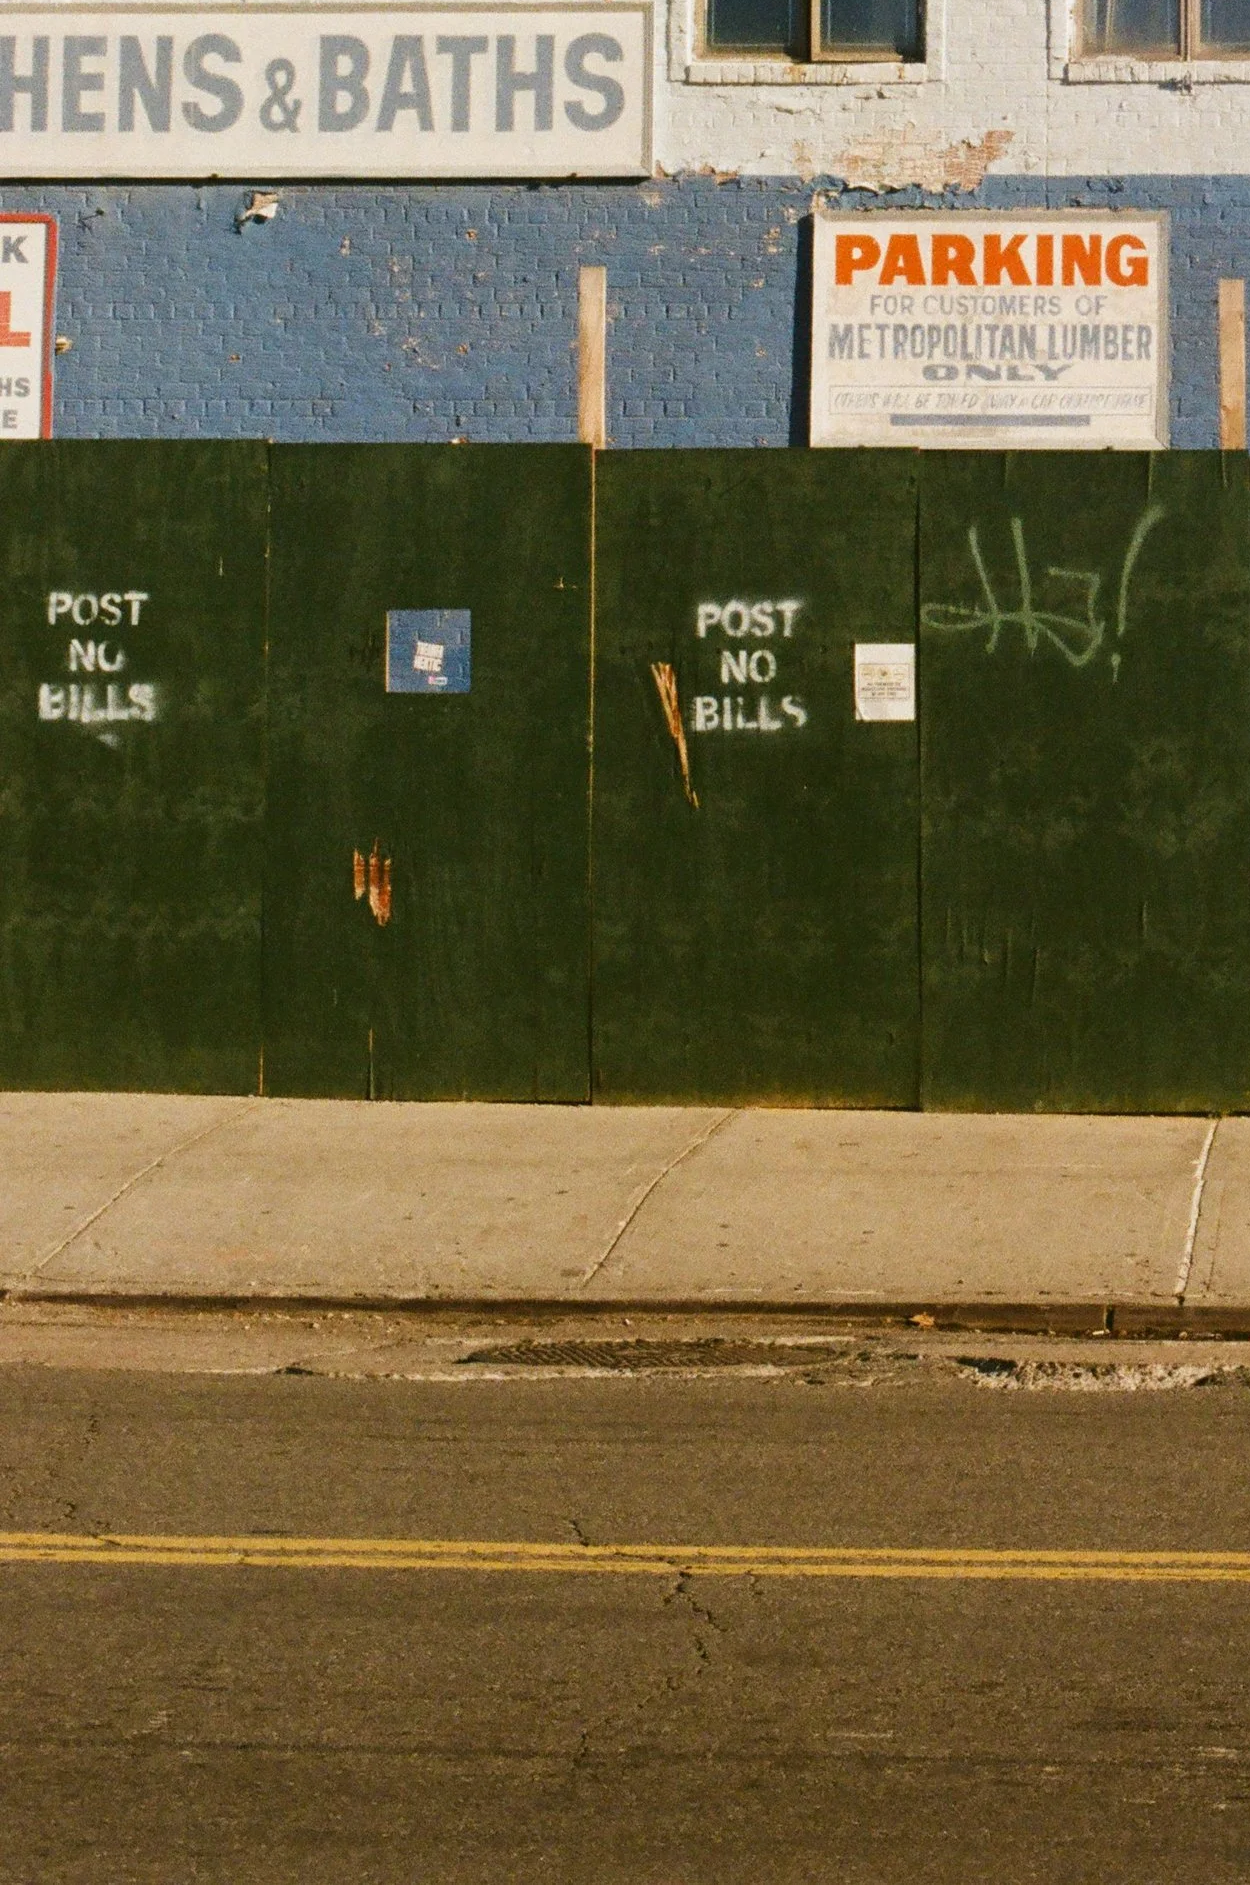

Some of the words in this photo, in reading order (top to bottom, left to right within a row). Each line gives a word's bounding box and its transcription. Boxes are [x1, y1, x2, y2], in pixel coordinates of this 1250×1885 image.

[0, 33, 244, 133] HENS
[318, 33, 626, 132] BATHS
[2, 236, 28, 263] K
[834, 233, 1149, 287] PARKING
[869, 294, 915, 316] FOR
[923, 294, 1062, 316] CUSTOMERS
[1074, 294, 1108, 315] OF
[828, 323, 1037, 360] METROPOLITAN
[1048, 323, 1152, 362] LUMBER
[922, 363, 1074, 382] ONLY
[48, 591, 150, 626] POST
[697, 599, 802, 638] POST
[69, 638, 126, 672] NO
[720, 649, 778, 684] NO
[38, 682, 157, 723] BILLS
[692, 695, 808, 731] BILLS
